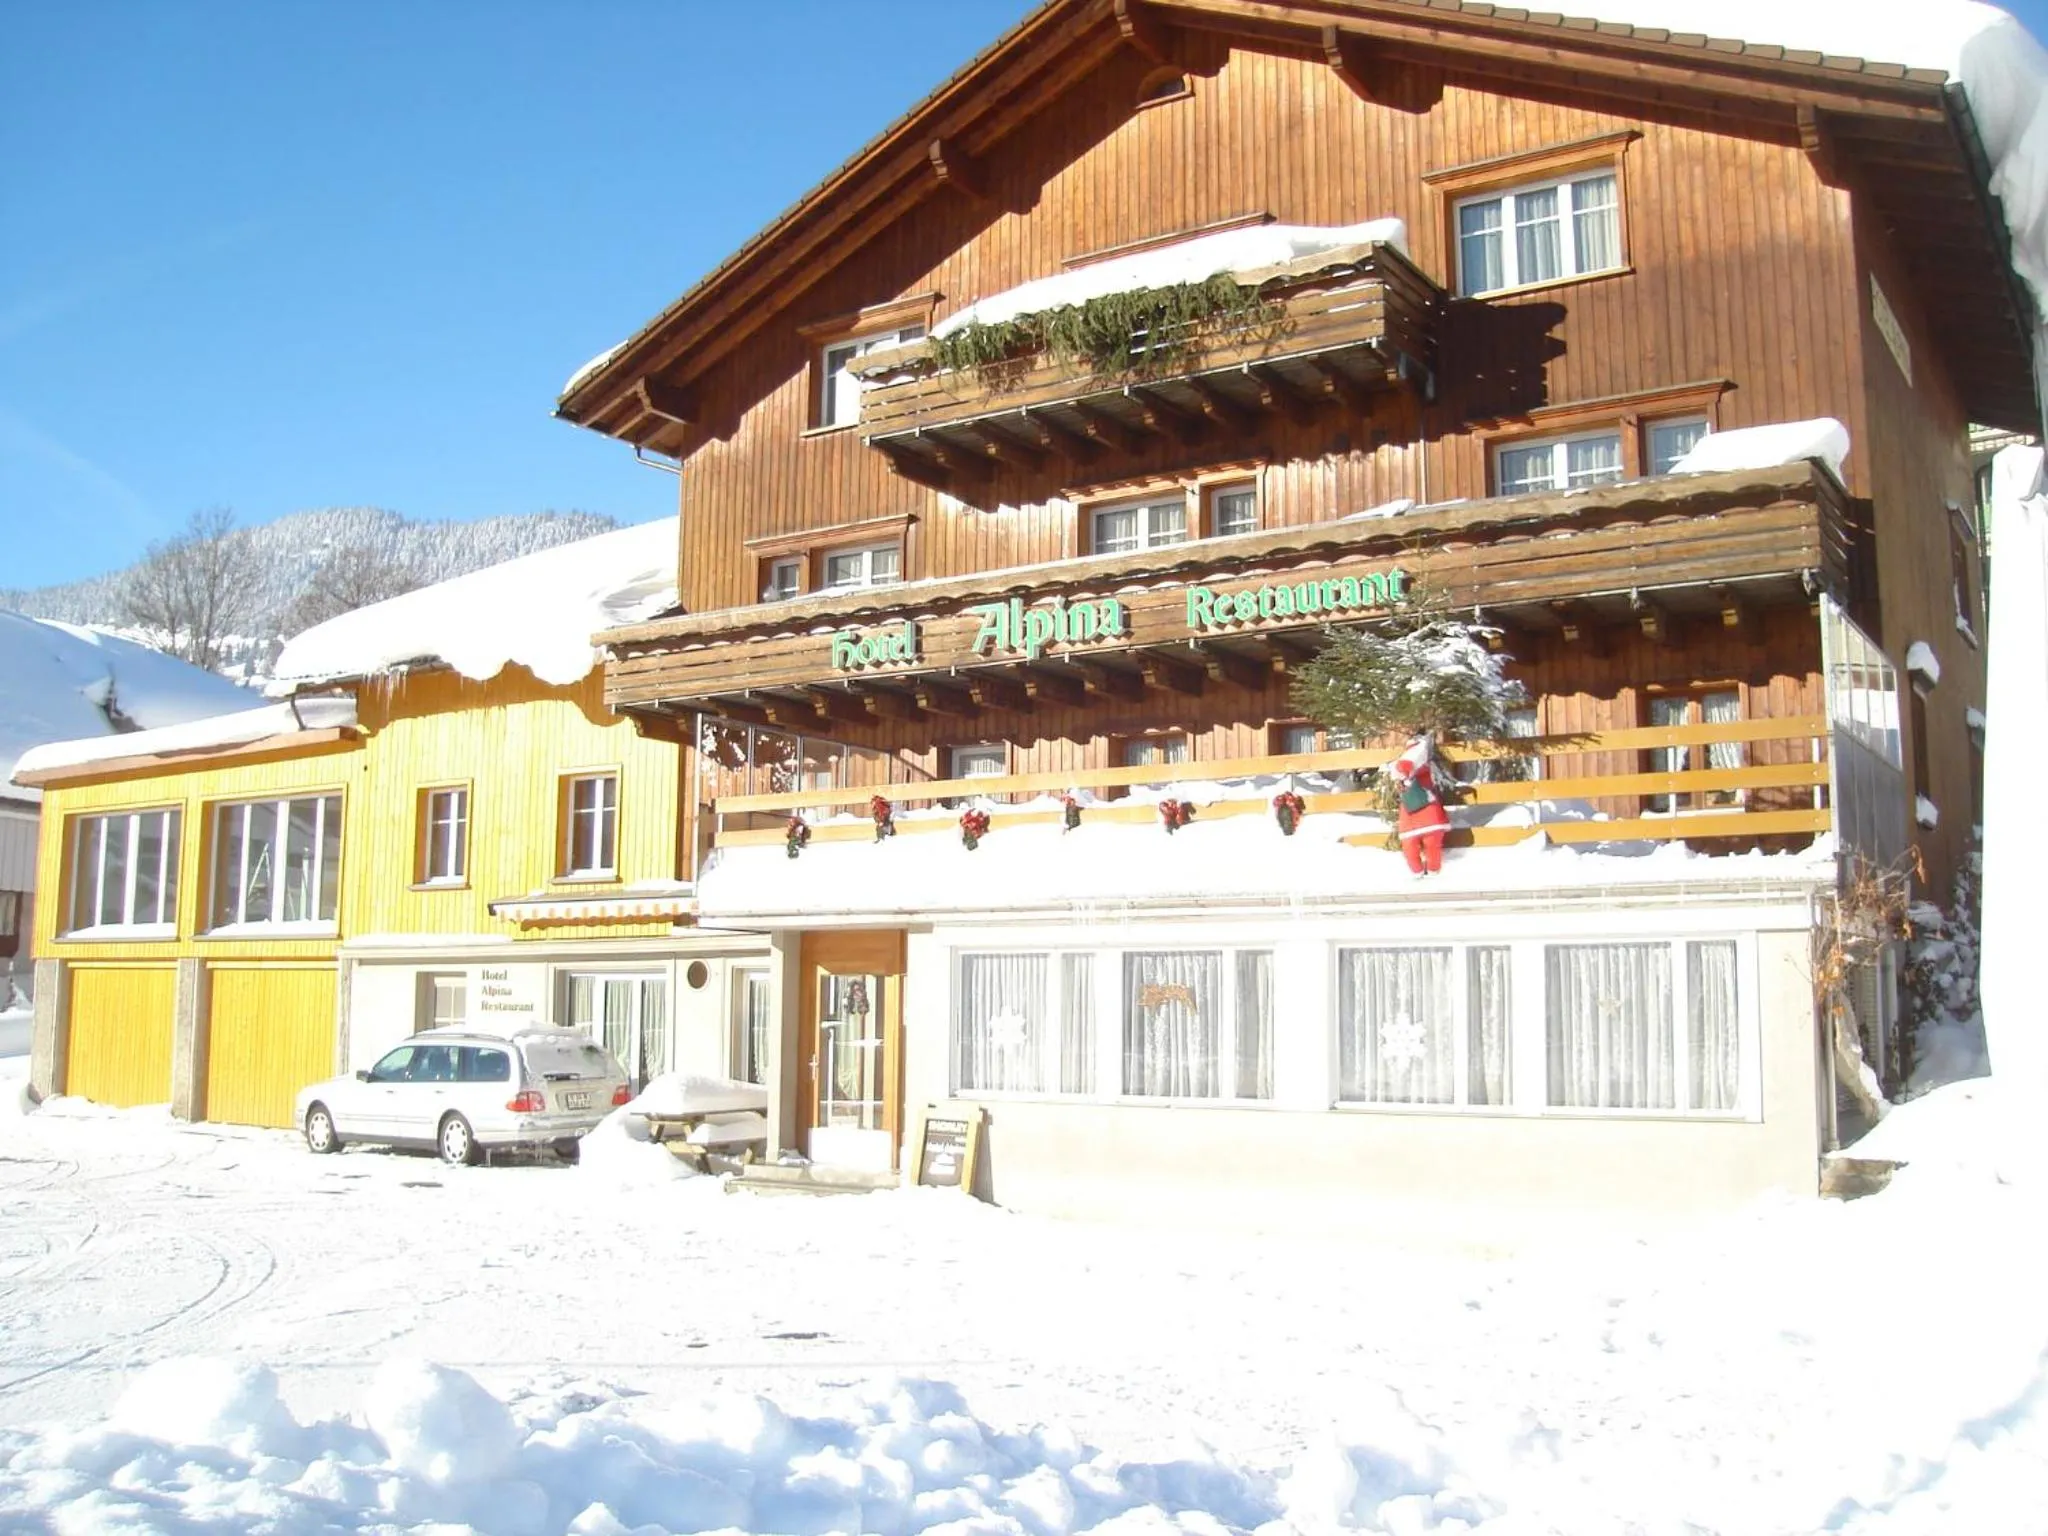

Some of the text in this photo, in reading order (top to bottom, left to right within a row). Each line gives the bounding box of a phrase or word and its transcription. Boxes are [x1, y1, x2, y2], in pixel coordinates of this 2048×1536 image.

[958, 596, 1126, 660] Alpina
[1186, 566, 1405, 629] Restaurant
[481, 968, 507, 981] Hotel
[481, 985, 513, 997] Alpina
[481, 1000, 534, 1012] Restaurant
